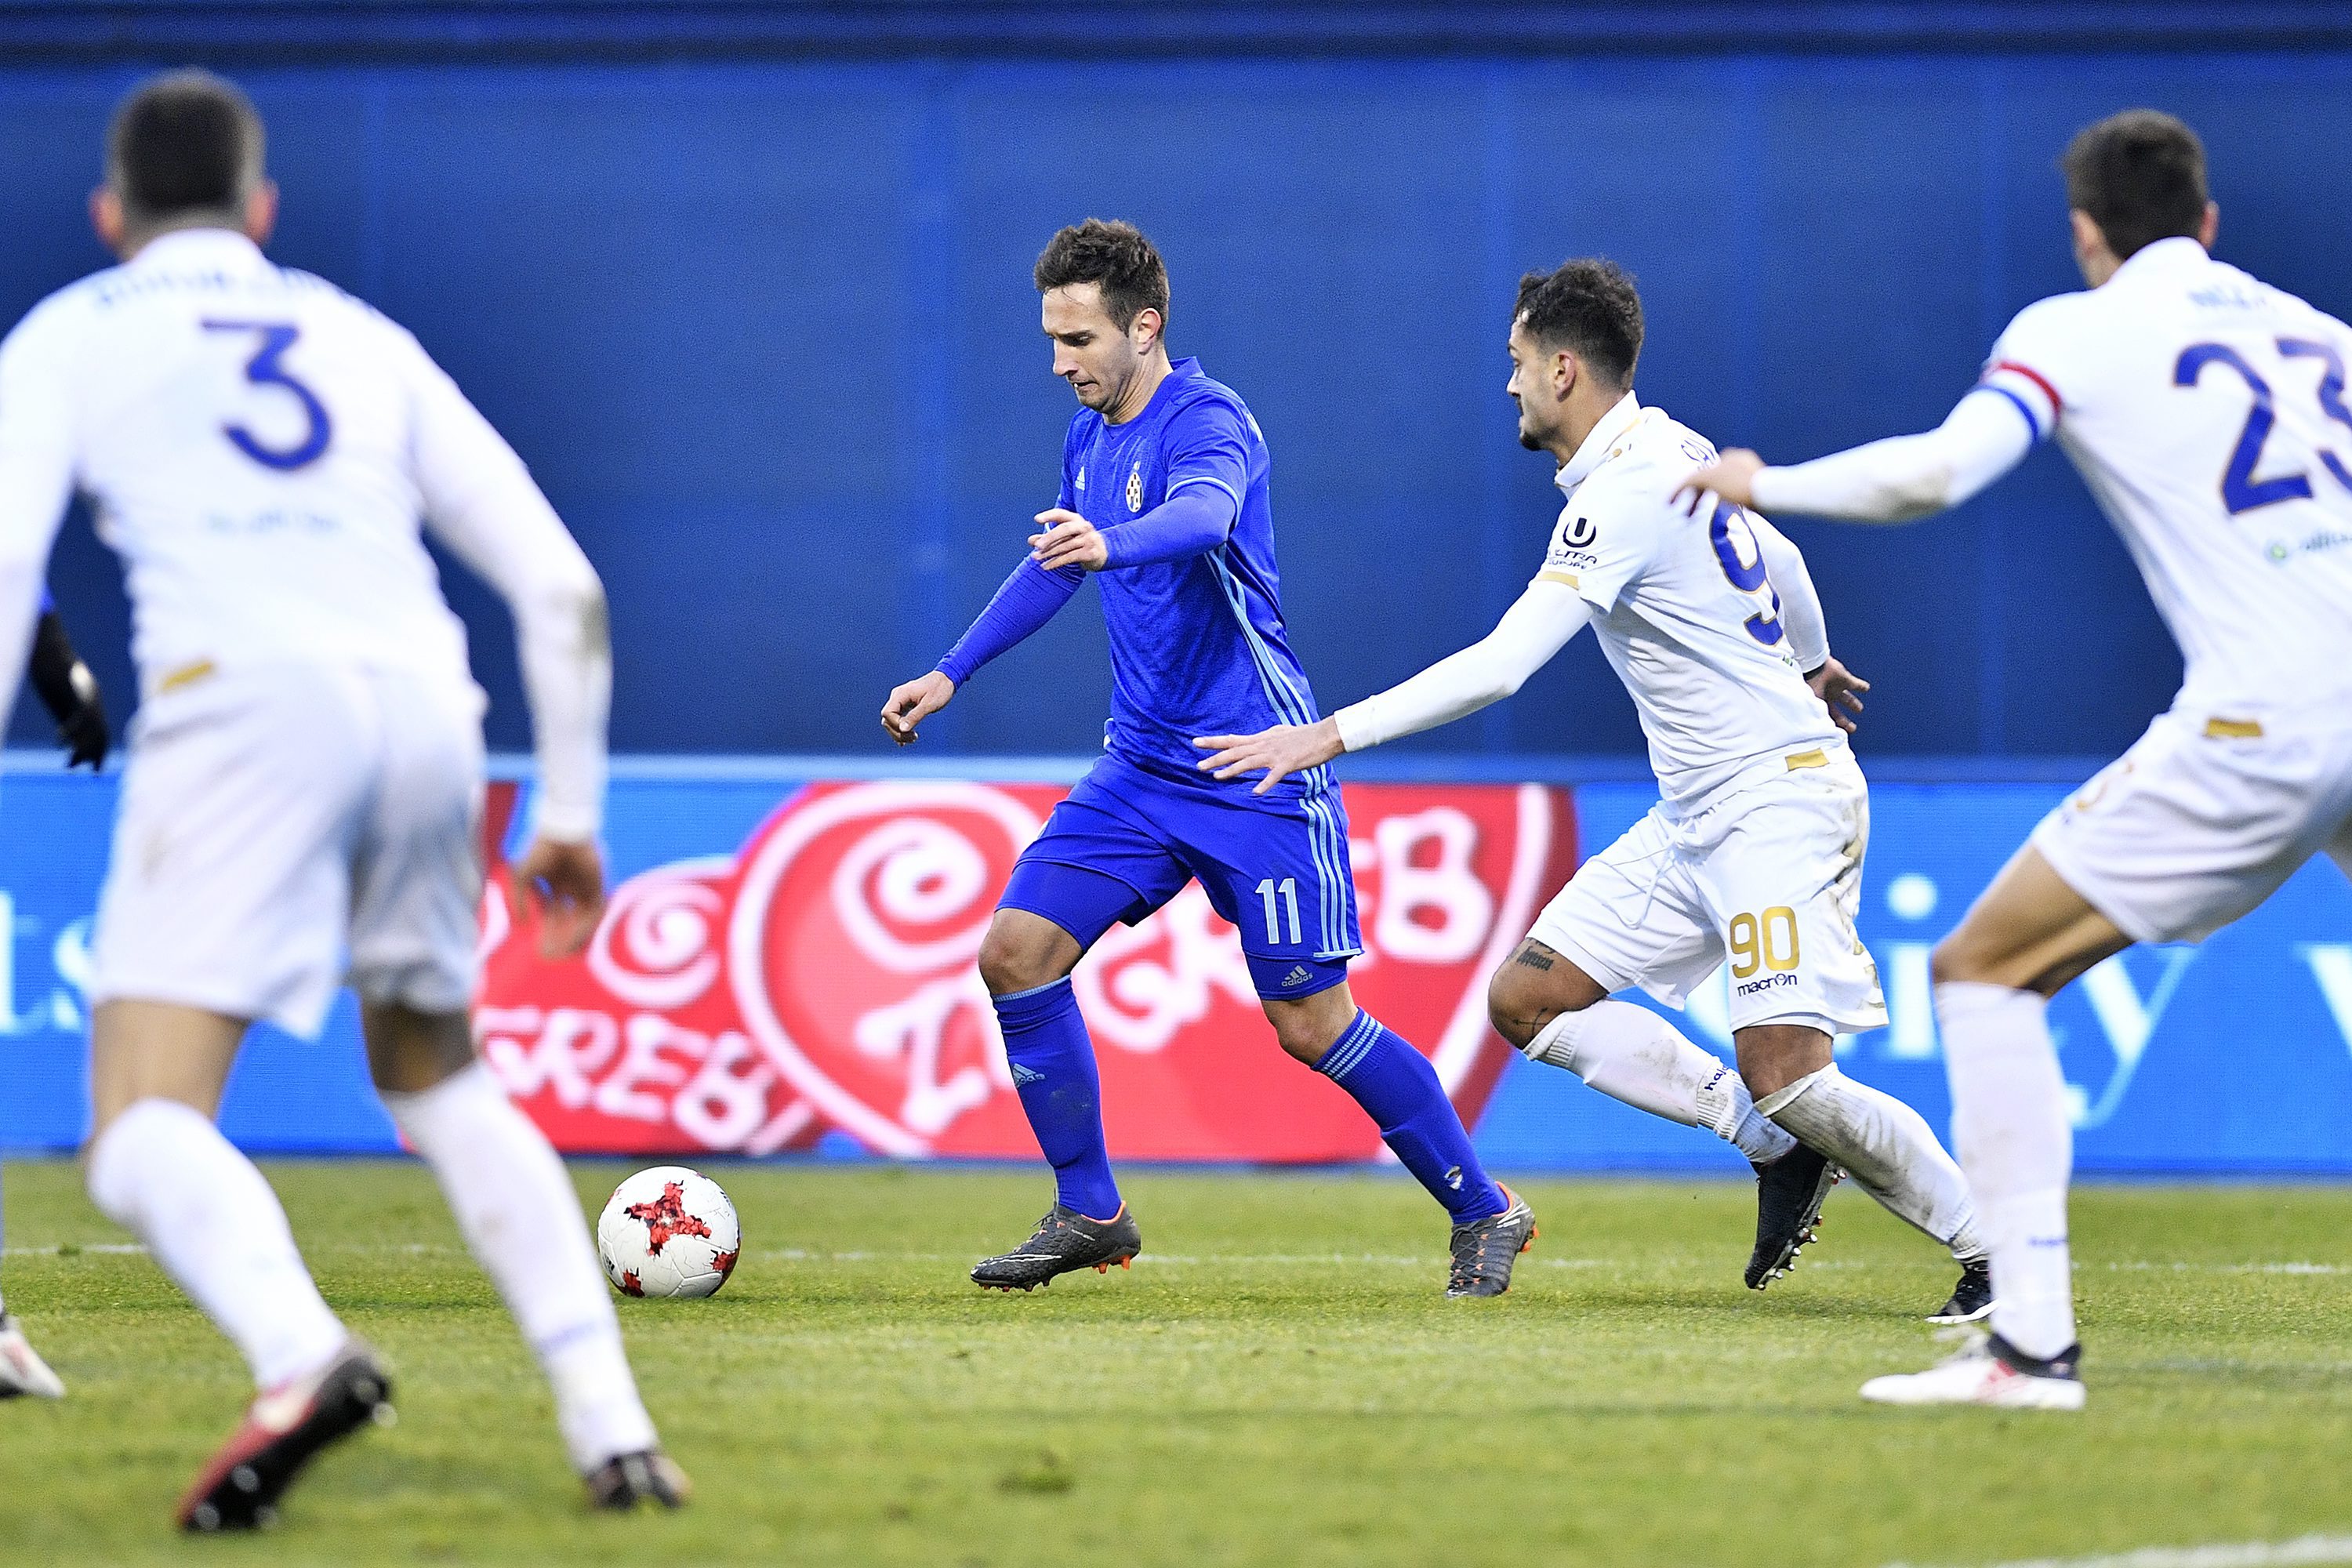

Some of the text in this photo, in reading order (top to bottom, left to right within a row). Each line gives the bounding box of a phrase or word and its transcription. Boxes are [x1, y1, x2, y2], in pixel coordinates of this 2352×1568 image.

[201, 314, 333, 471] 3
[2172, 337, 2352, 516] 23
[1255, 878, 1301, 945] 11
[1730, 906, 1800, 979] 90
[1281, 972, 1313, 987] adidas
[1737, 973, 1798, 997] macron
